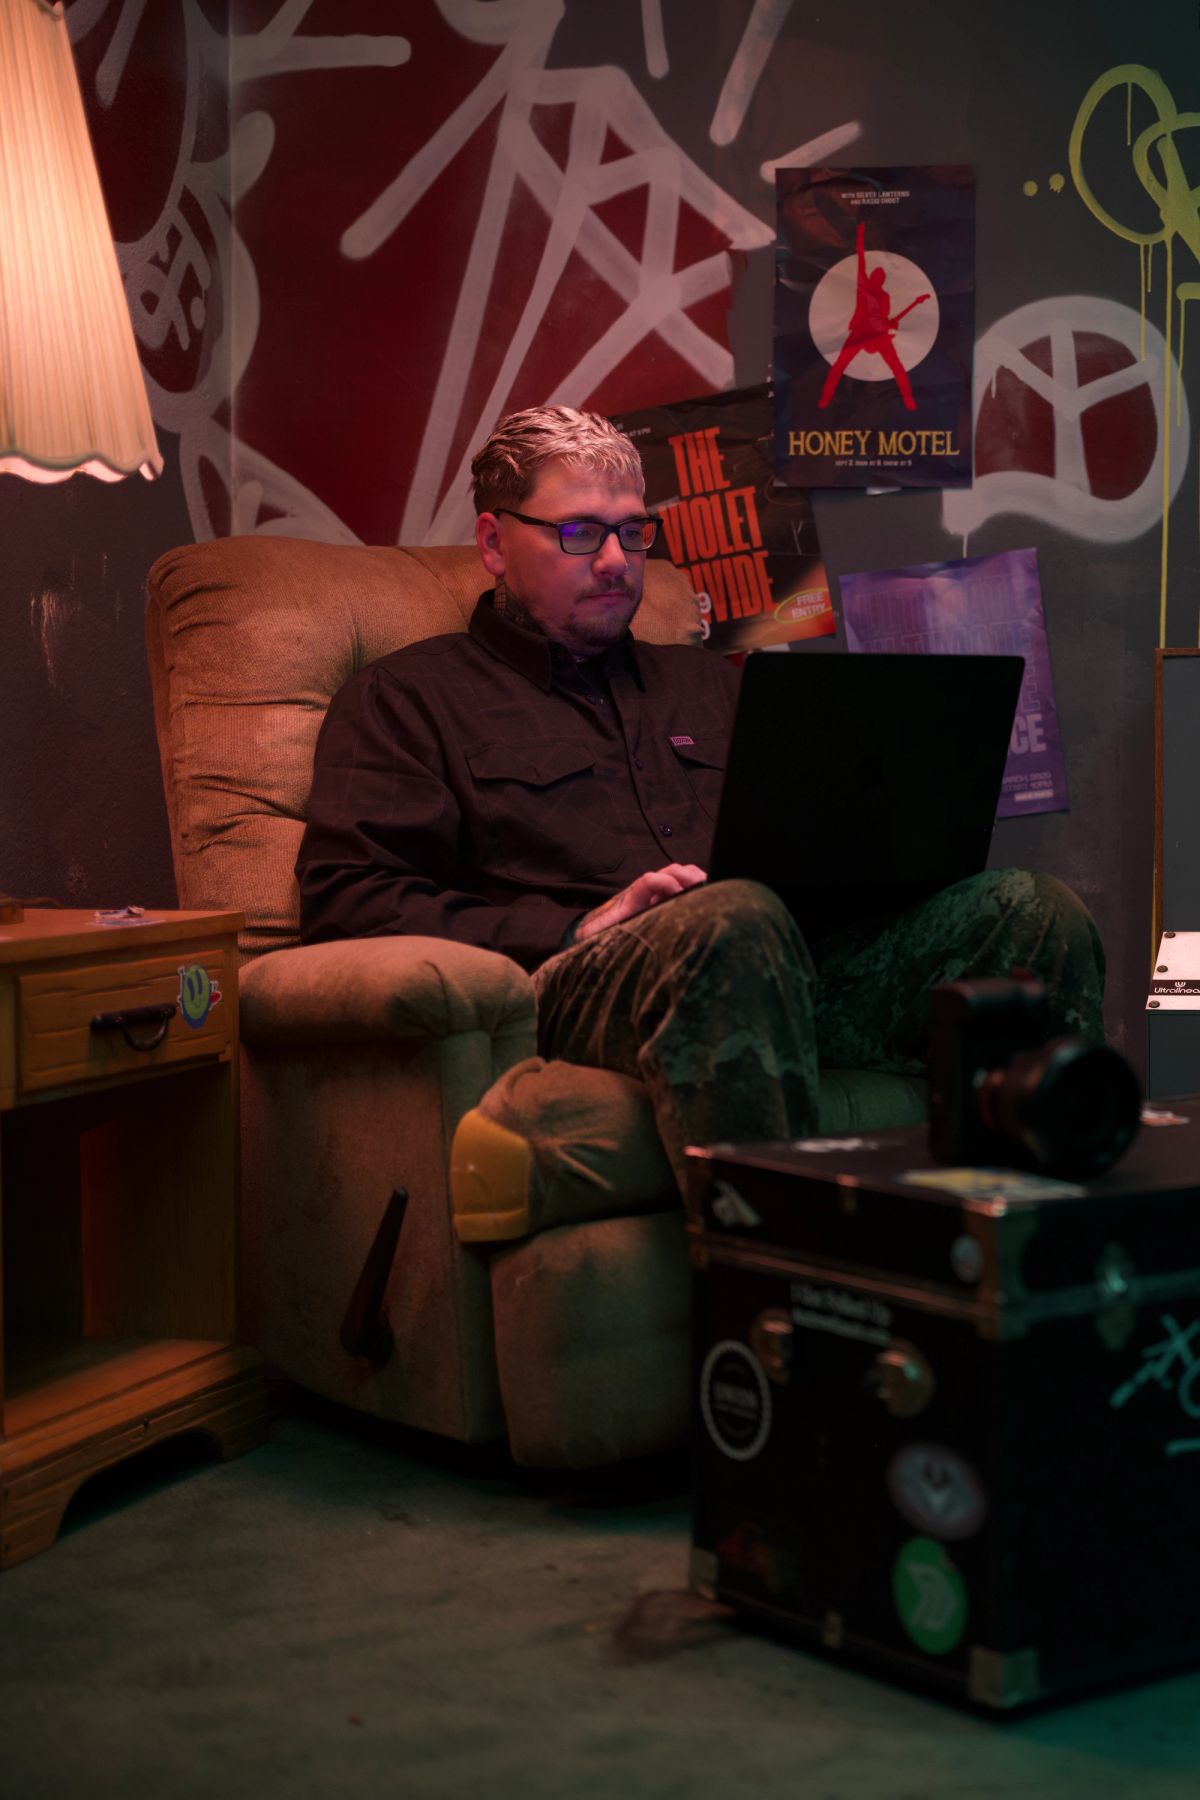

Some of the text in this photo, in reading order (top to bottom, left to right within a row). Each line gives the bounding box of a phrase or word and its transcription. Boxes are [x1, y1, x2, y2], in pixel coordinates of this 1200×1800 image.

[668, 426, 731, 497] THE
[788, 430, 961, 456] HONEY MOTEL
[658, 486, 763, 565] VIOLET
[679, 549, 776, 623] IVIDE
[792, 602, 826, 618] ENTRY
